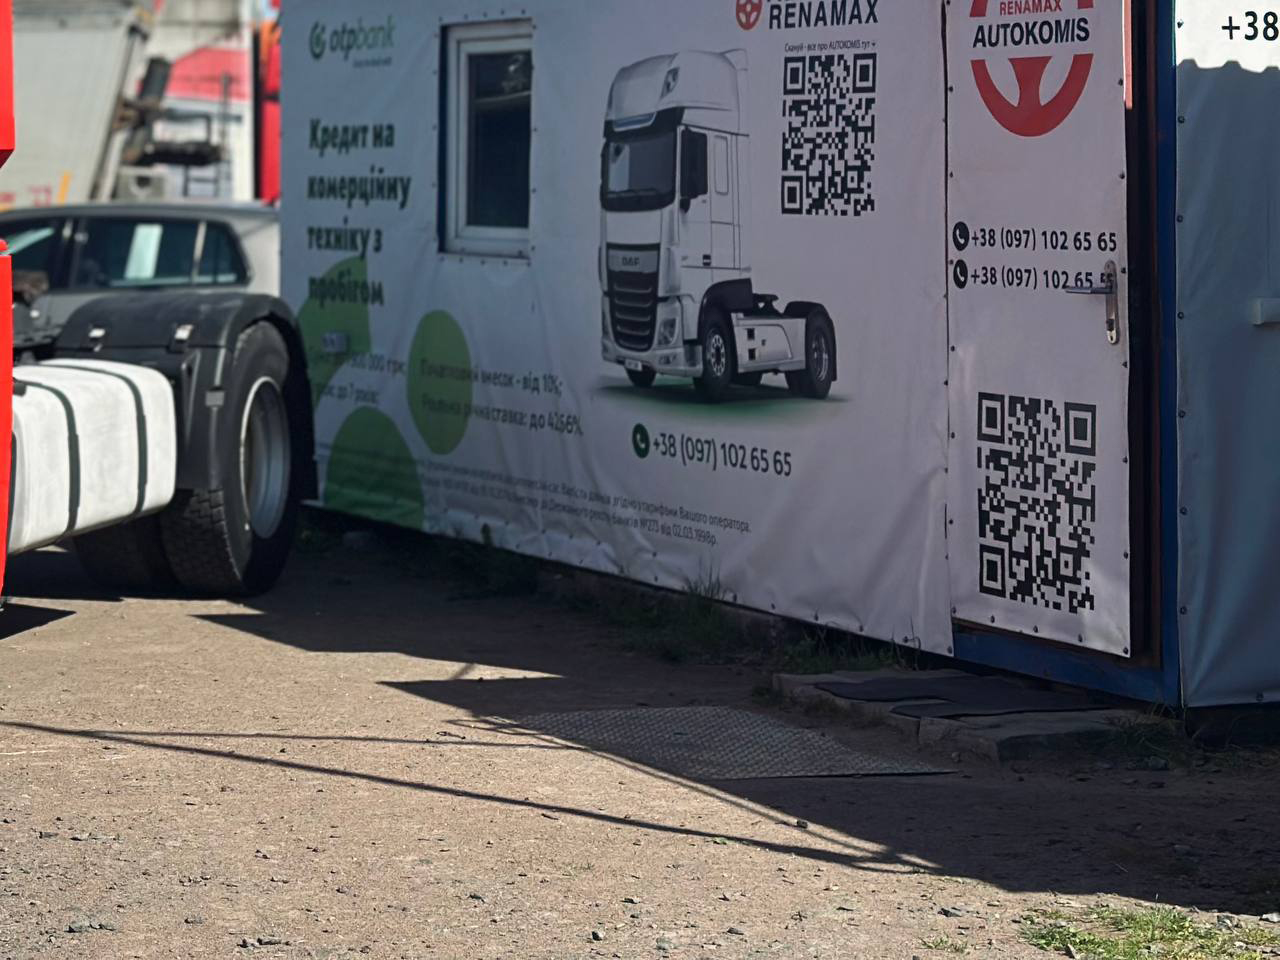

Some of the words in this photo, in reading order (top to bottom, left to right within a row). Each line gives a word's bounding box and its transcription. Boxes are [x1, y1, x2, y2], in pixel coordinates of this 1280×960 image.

[973, 17, 1090, 48] AUTOKOMIS
[1221, 10, 1280, 41] +38
[309, 119, 369, 157] Кредит
[373, 122, 395, 148] на
[307, 164, 411, 209] комерційну
[307, 216, 371, 259] техніку
[373, 228, 383, 253] з
[971, 227, 996, 248] +38
[1000, 227, 1036, 251] (097)
[1041, 230, 1069, 251] 102
[1073, 231, 1092, 251] 65
[1097, 231, 1117, 252] 65
[308, 268, 384, 308] пробігом
[971, 266, 997, 286] +38
[1001, 265, 1038, 290] (097)
[1043, 269, 1069, 289] 102
[1074, 271, 1093, 288] 65
[529, 413, 545, 432] до
[653, 432, 677, 458] +38
[680, 432, 717, 471] (097)
[720, 441, 747, 470] 102
[750, 446, 769, 473] 65
[773, 450, 792, 477] 65
